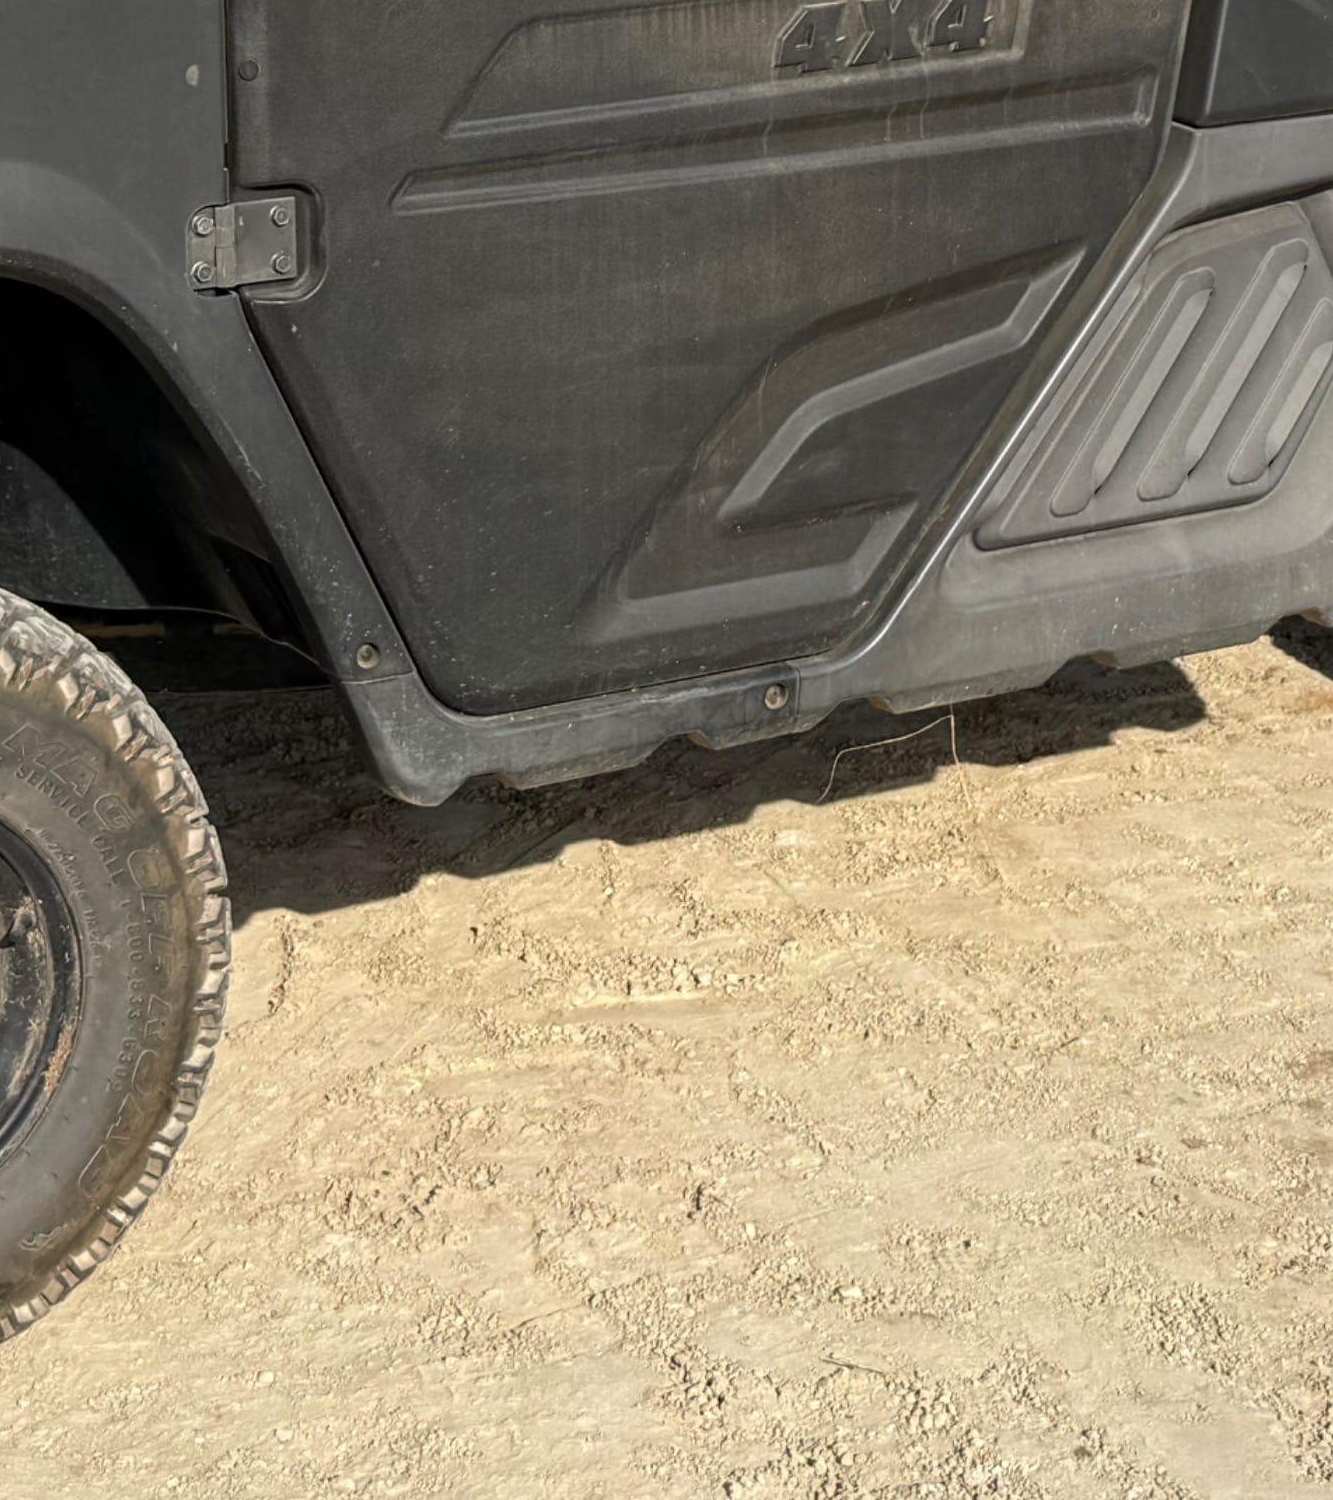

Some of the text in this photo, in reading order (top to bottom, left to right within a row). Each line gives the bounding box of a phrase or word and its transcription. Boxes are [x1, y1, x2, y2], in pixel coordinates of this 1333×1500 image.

[0, 722, 136, 832] MAG
[15, 766, 88, 829] SERVICE
[91, 833, 125, 887] CALL
